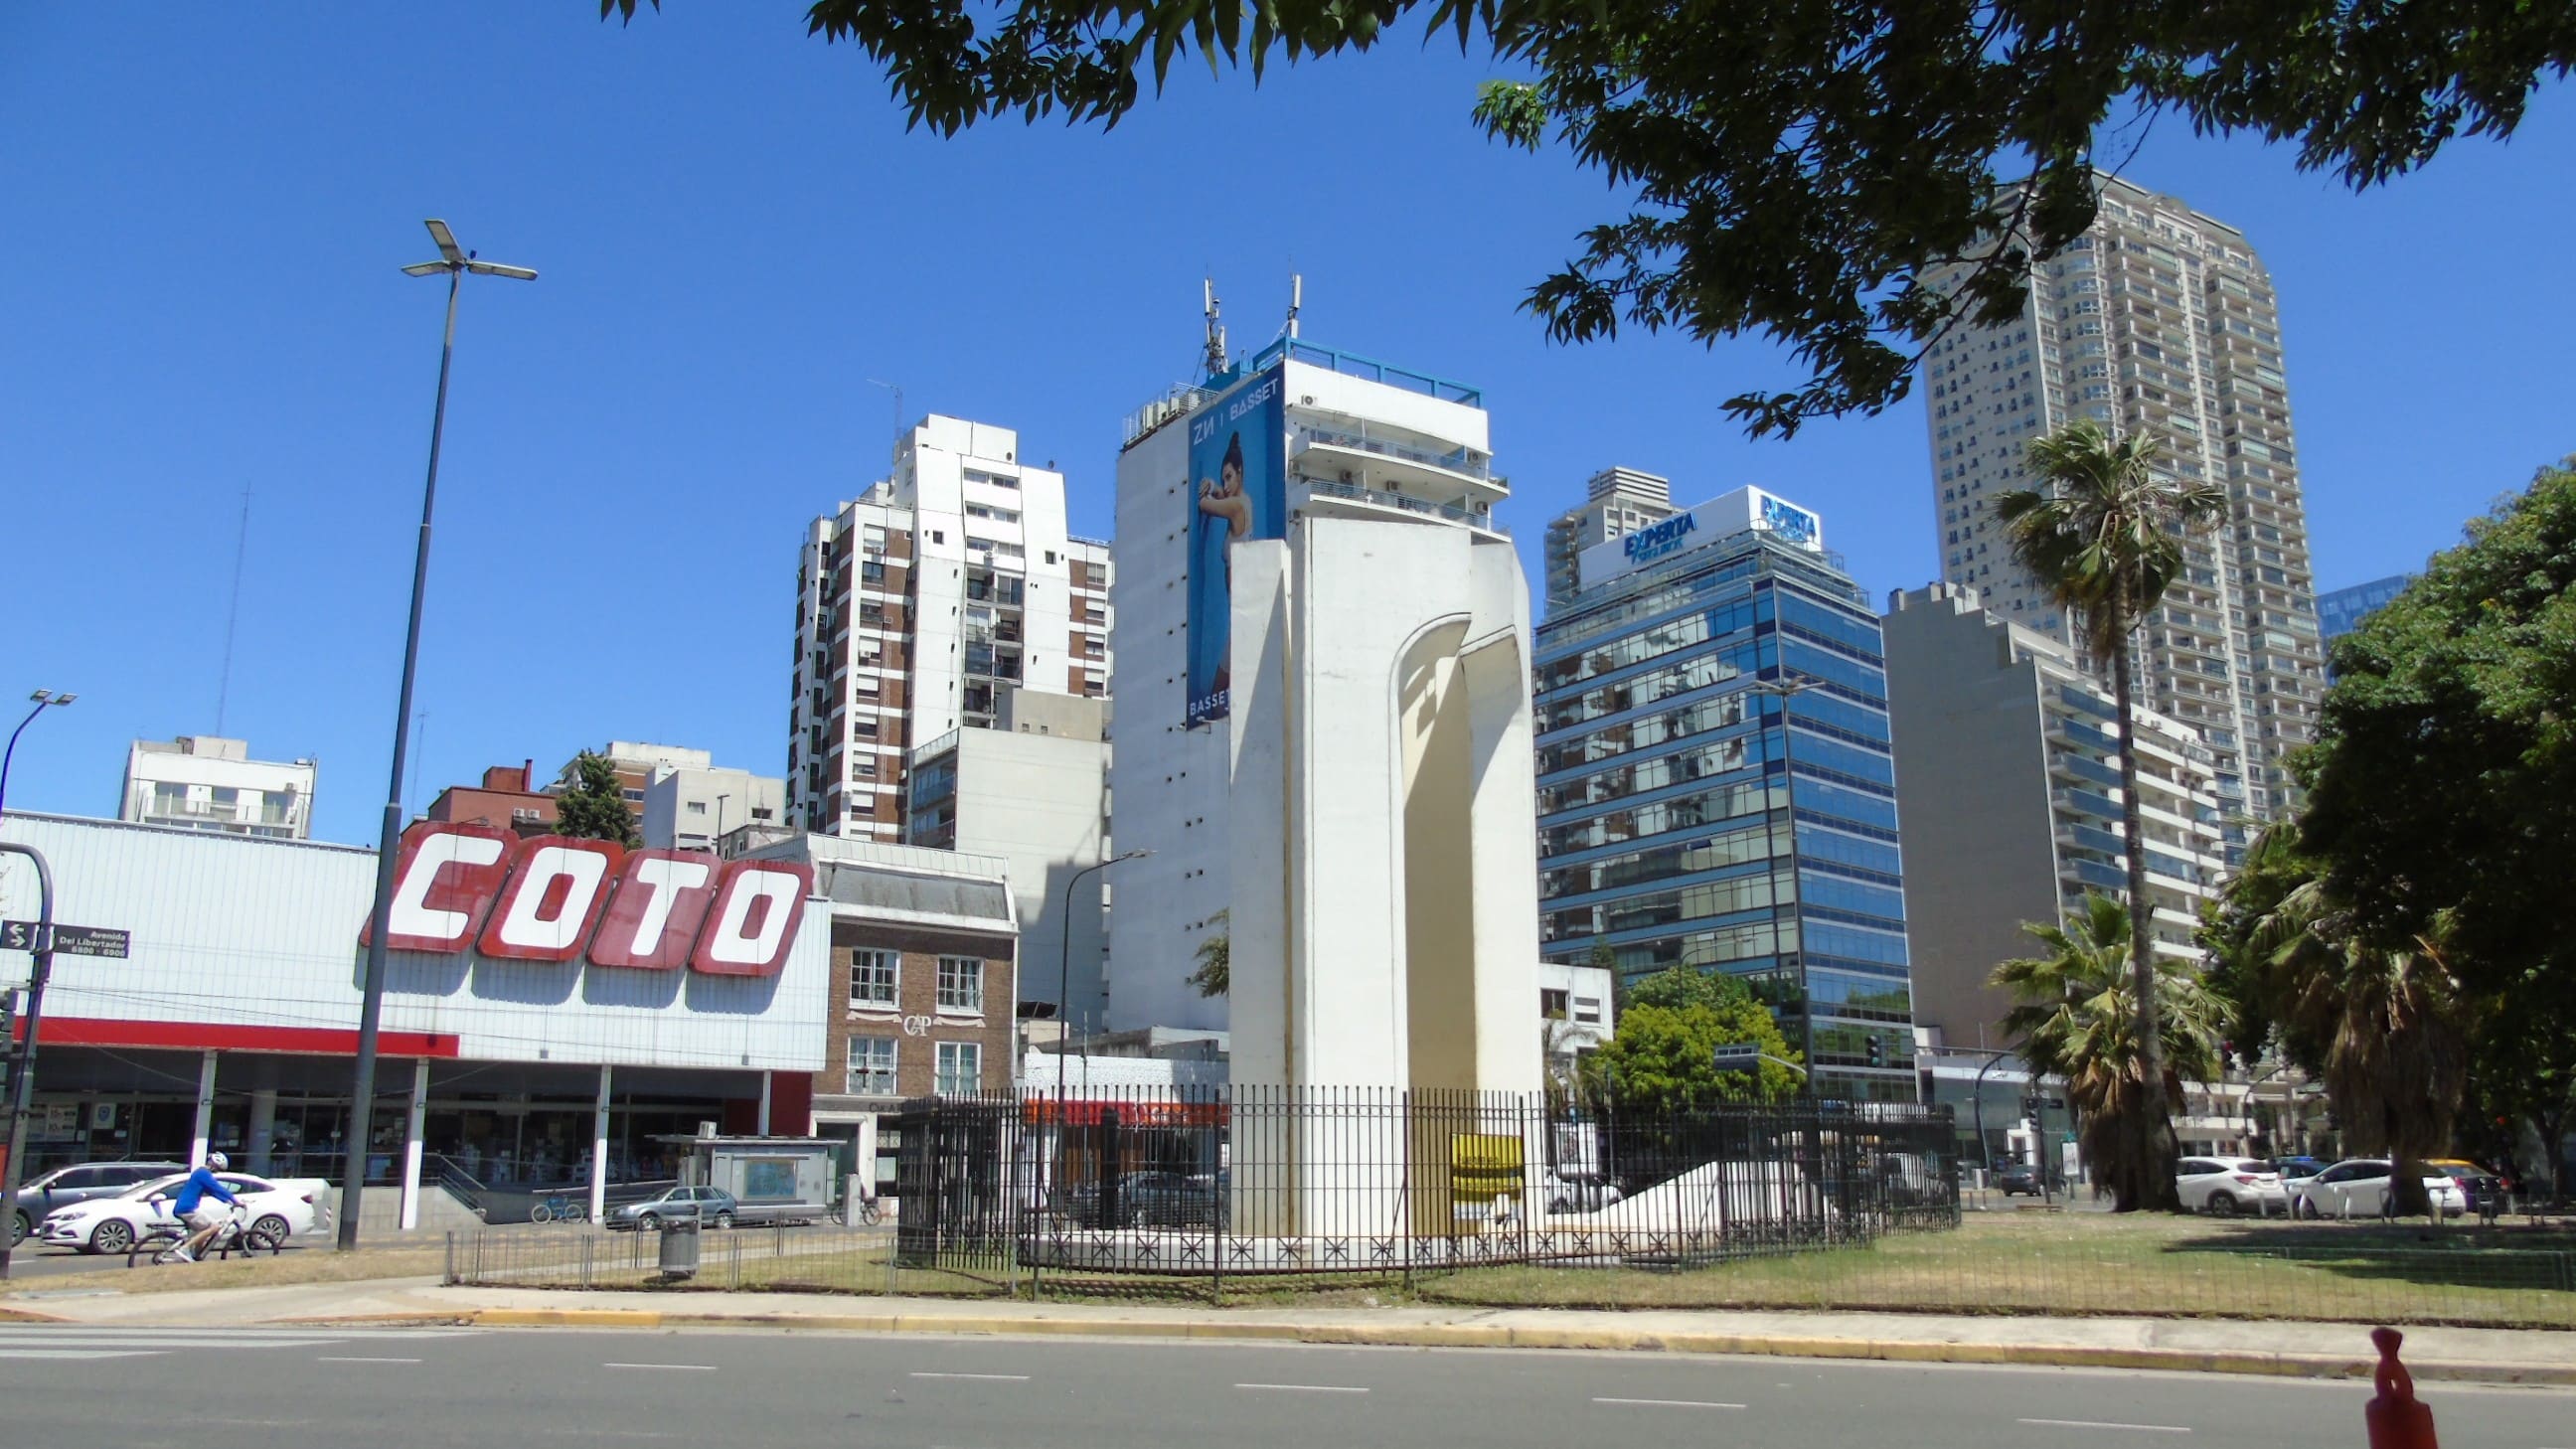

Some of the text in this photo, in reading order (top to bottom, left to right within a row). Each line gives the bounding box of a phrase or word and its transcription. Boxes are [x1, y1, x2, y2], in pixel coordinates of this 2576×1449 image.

[1229, 378, 1279, 421] BASSET
[1624, 511, 1696, 564] EXPERTA
[388, 832, 801, 964] COTO
[59, 936, 125, 948] Del Libertador
[90, 930, 126, 941] Avenida
